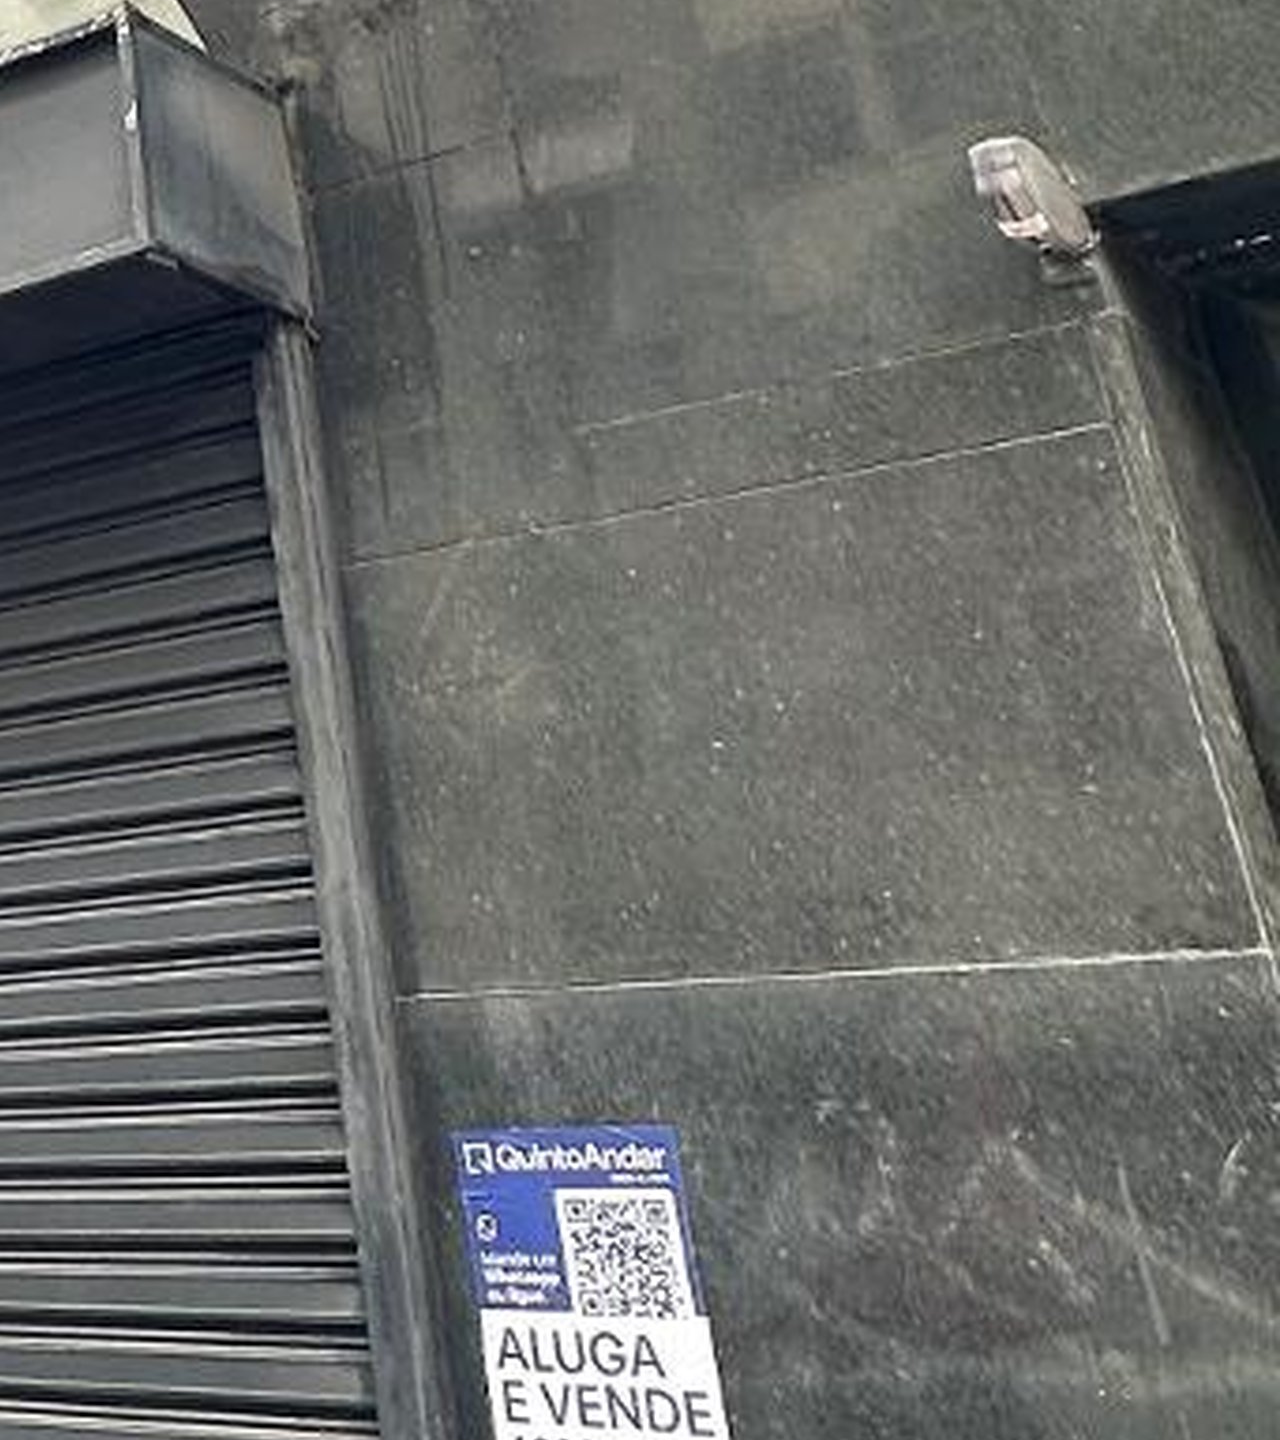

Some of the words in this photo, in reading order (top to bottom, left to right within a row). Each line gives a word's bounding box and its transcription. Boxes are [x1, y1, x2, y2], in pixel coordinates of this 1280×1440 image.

[495, 1142, 667, 1173] QuintoAndar
[496, 1326, 666, 1379] ALUGA
[502, 1380, 530, 1423] E
[539, 1381, 716, 1438] VENDE
